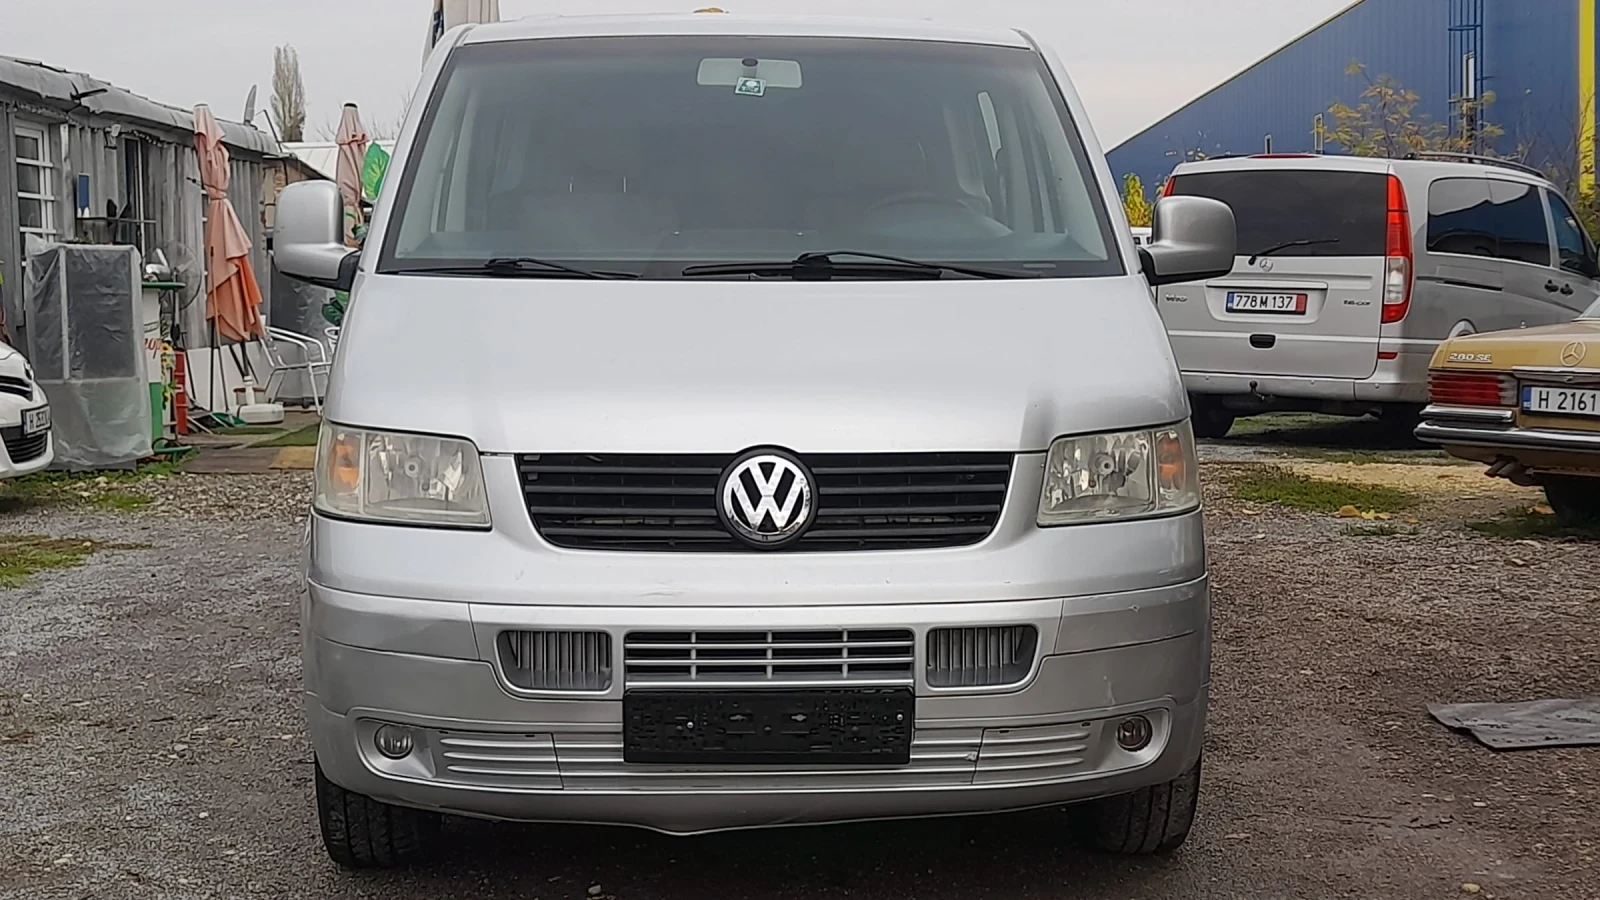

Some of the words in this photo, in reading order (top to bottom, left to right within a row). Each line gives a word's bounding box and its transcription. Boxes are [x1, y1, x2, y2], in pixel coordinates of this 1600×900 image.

[1236, 295, 1258, 308] 778
[1259, 295, 1269, 309] M
[1272, 296, 1293, 309] 137
[1449, 352, 1475, 361] 280
[1476, 353, 1492, 361] SE
[1538, 390, 1550, 409] H
[1557, 391, 1597, 412] 2161
[726, 457, 808, 538] VW
